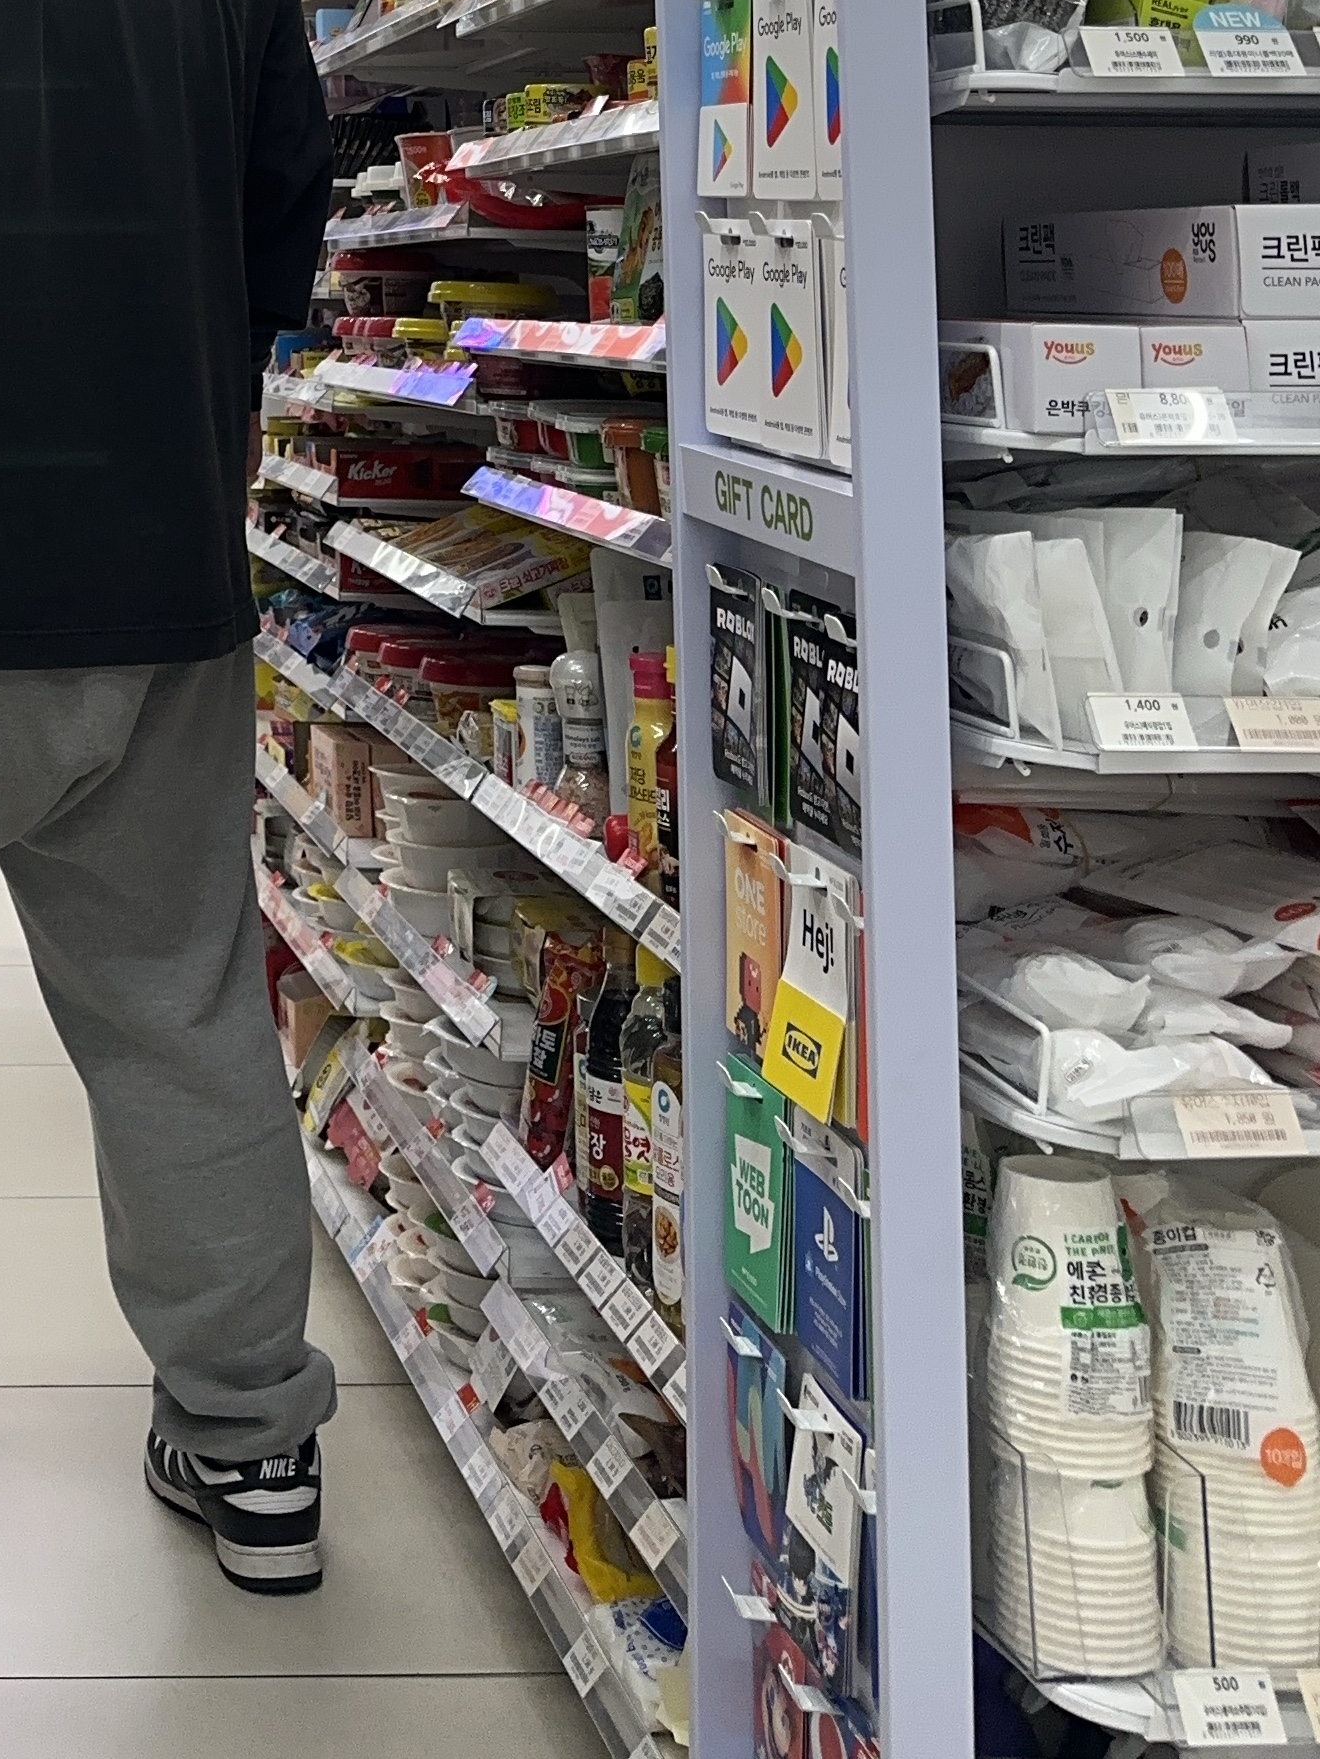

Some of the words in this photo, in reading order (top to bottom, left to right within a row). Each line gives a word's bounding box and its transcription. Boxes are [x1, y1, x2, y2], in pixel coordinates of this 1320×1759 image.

[757, 15, 784, 39] Google
[786, 11, 802, 36] Play
[1210, 11, 1263, 28] NEW
[703, 35, 731, 60] Google
[731, 32, 748, 56] Play
[1235, 34, 1260, 46] 990
[708, 258, 736, 284] Google
[738, 259, 755, 286] Play
[762, 261, 791, 290] Google
[791, 263, 808, 289] Play
[1263, 276, 1302, 287] CLEAN
[1043, 340, 1095, 360] youus
[1151, 342, 1203, 362] youus
[715, 470, 753, 521] GIFT
[761, 484, 814, 542] CARD
[1125, 699, 1161, 712] 1,400
[734, 865, 766, 916] ONE
[734, 906, 768, 948] store
[802, 907, 835, 974] Hej!
[786, 1031, 819, 1072] IKEA
[738, 1156, 767, 1199] WEB
[735, 1180, 771, 1230] TOON
[259, 1457, 297, 1480] NIKE
[1212, 1677, 1240, 1692] 500
